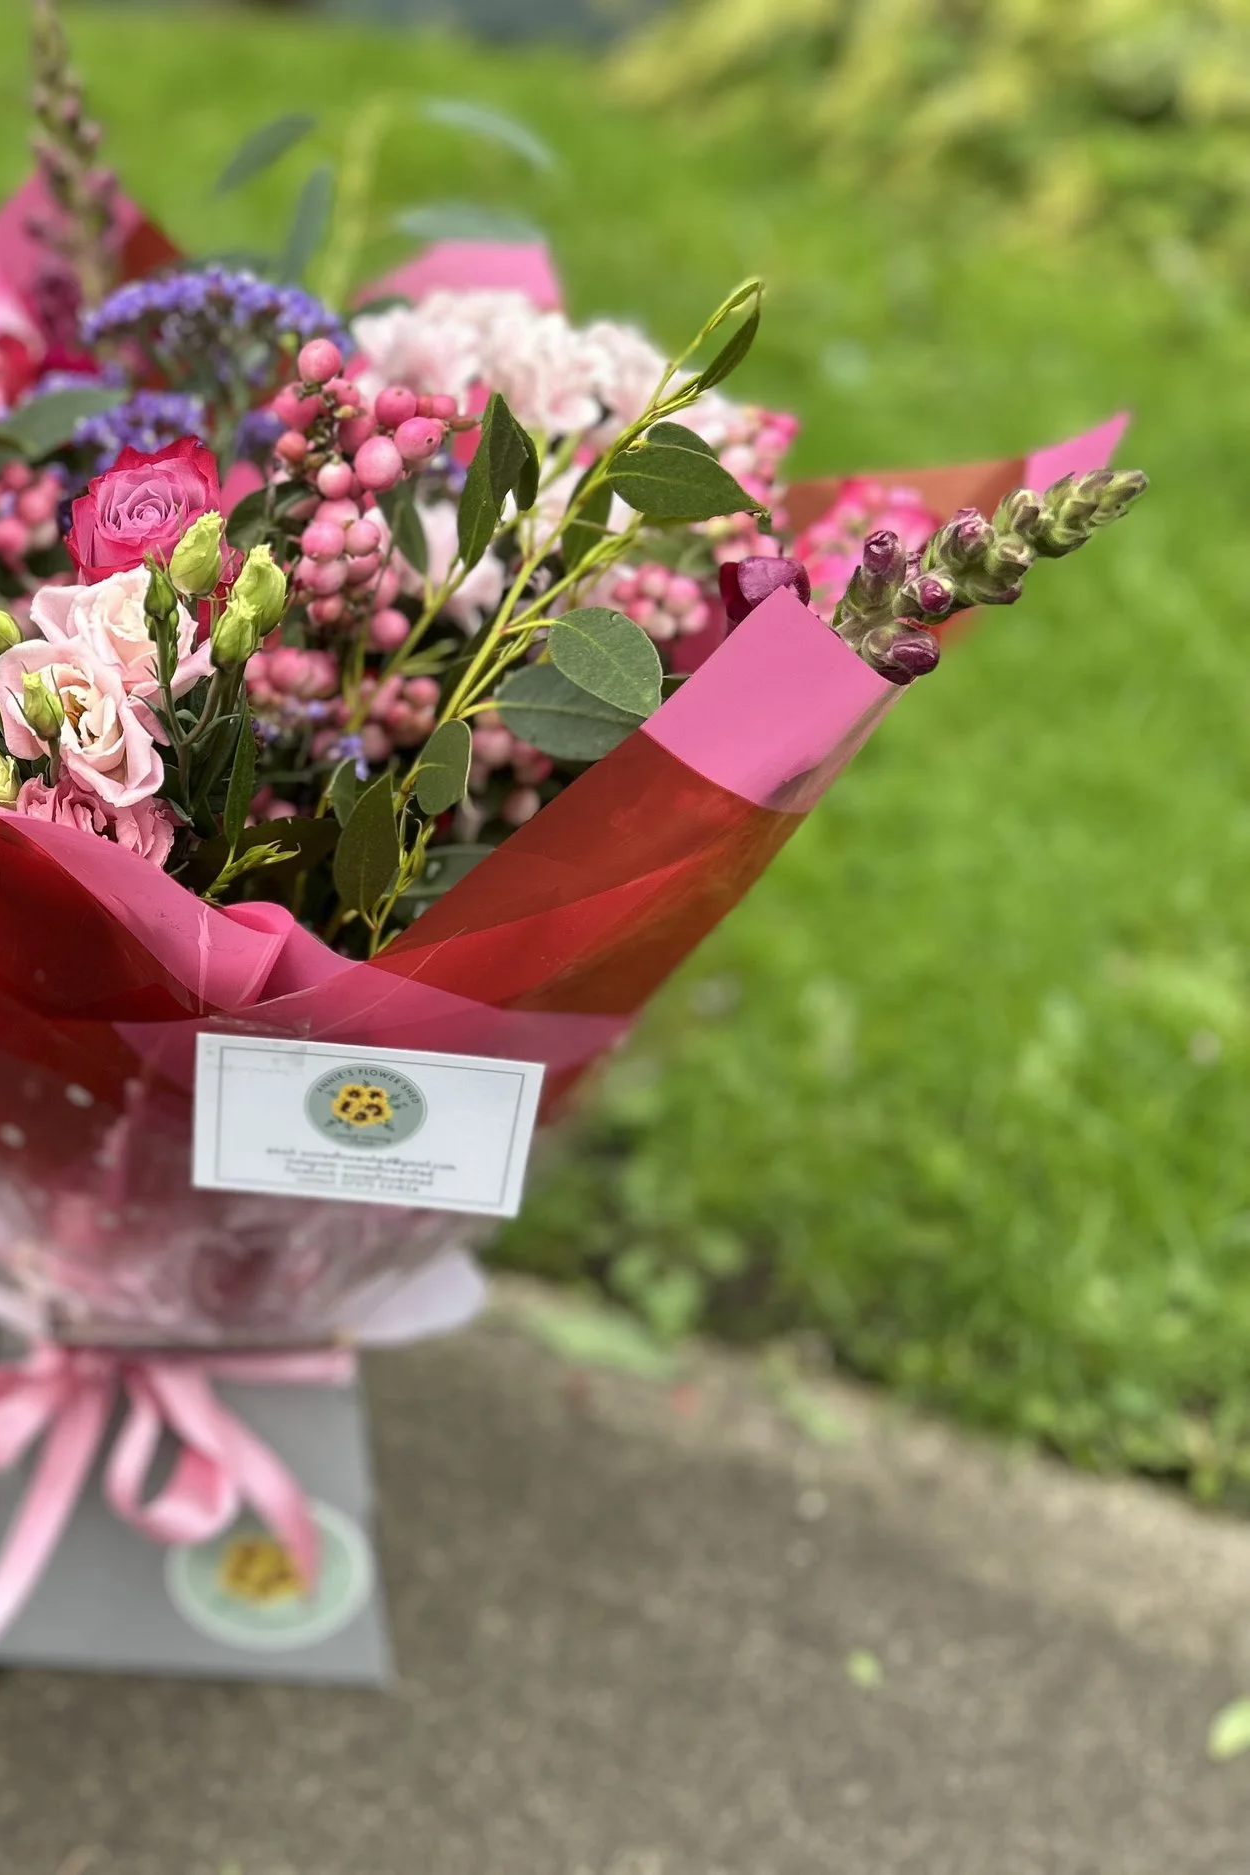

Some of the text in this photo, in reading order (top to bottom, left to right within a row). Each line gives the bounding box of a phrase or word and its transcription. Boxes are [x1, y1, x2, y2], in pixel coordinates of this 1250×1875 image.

[317, 1068, 420, 1105] ANNIE'S FLOWER SHED
